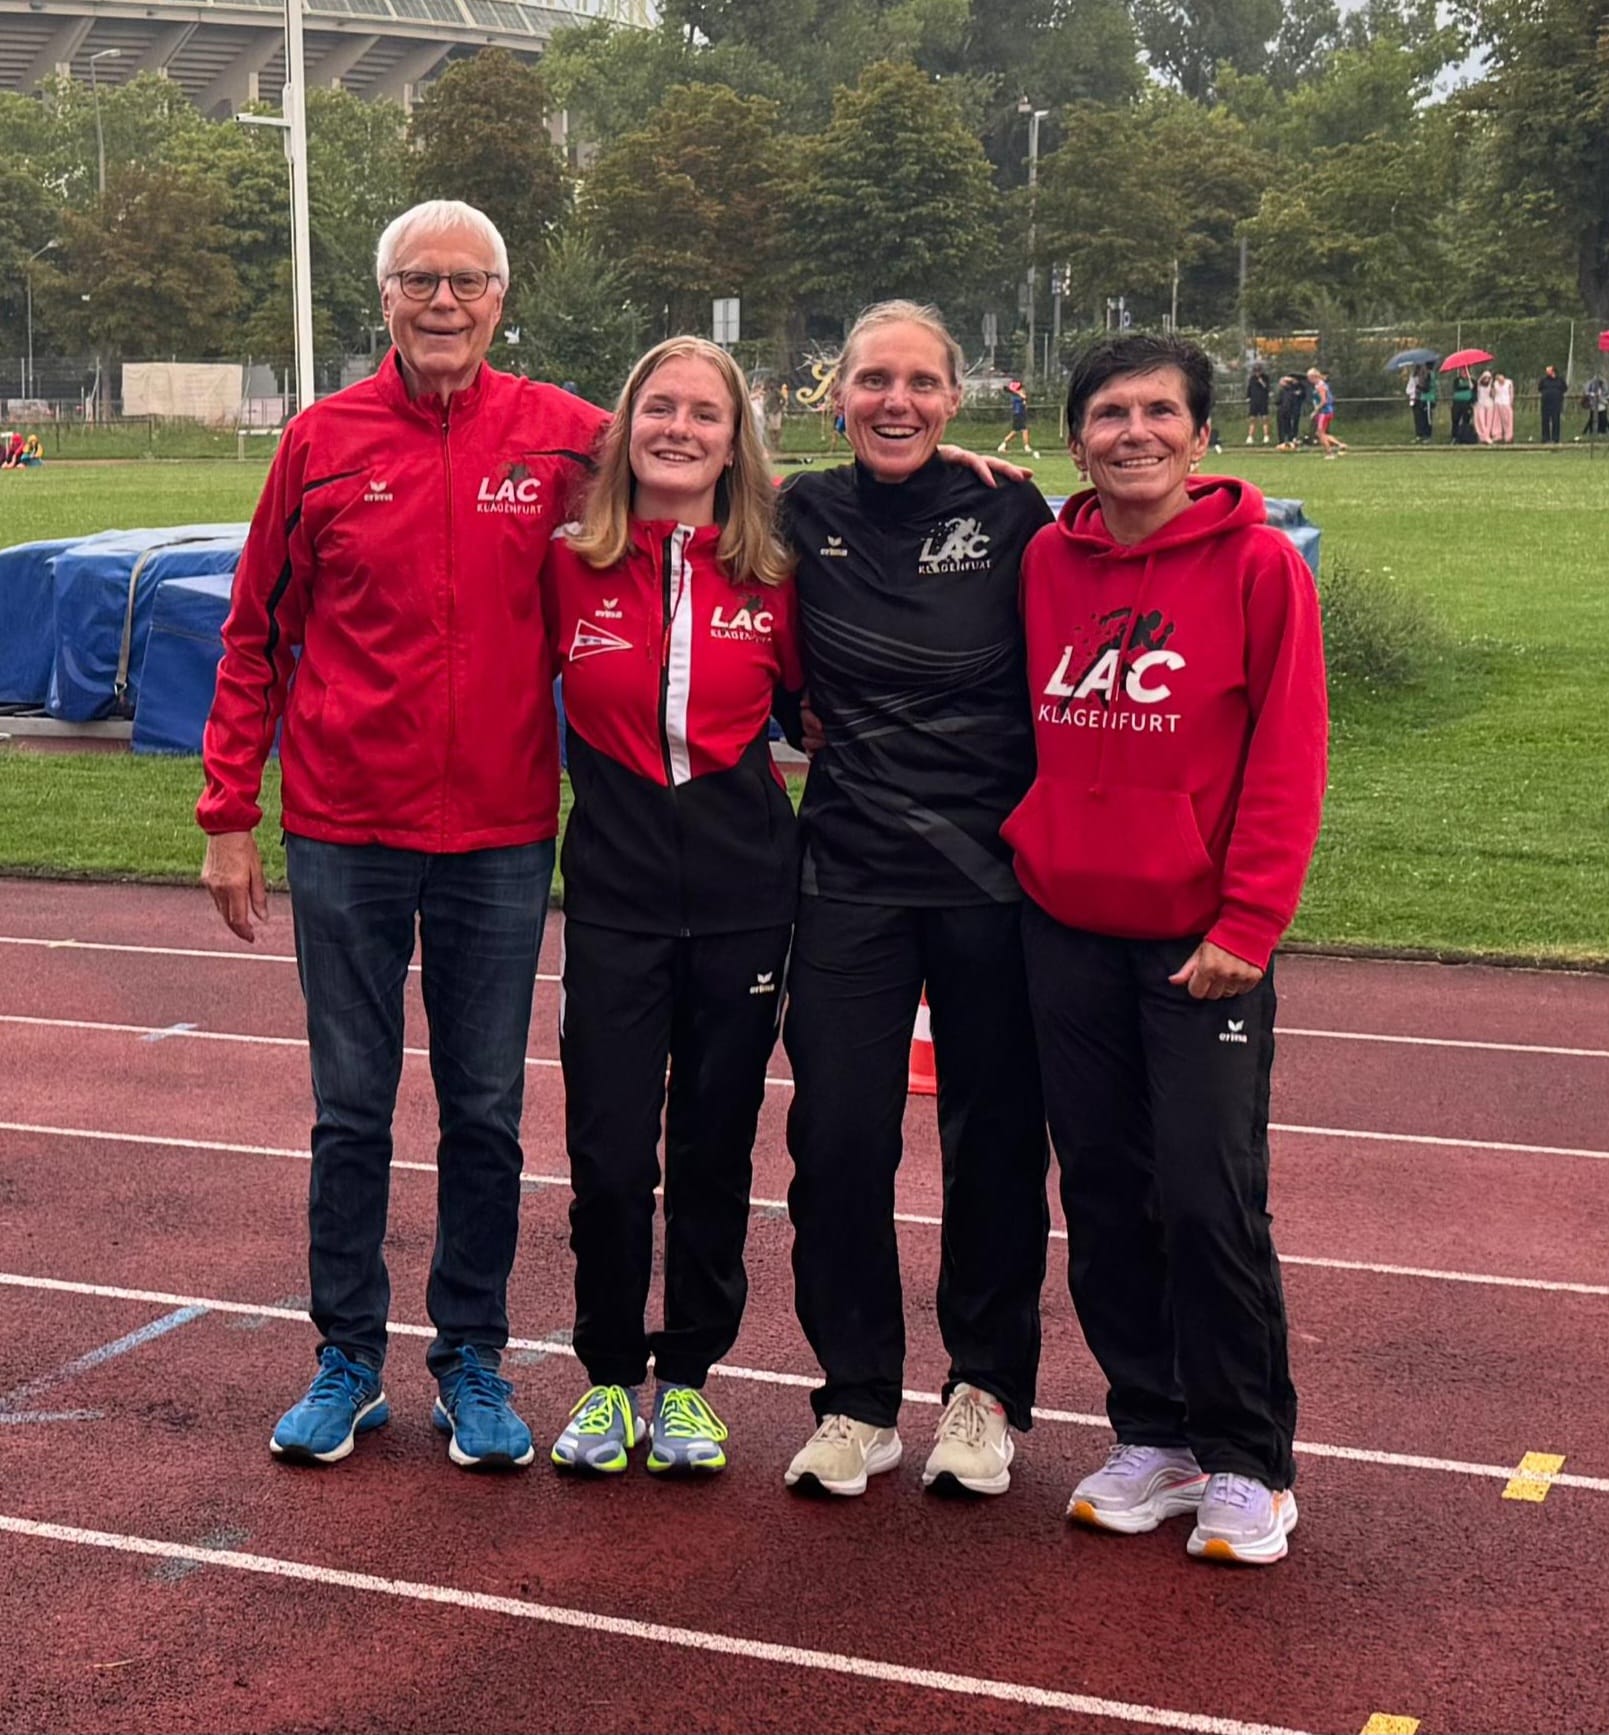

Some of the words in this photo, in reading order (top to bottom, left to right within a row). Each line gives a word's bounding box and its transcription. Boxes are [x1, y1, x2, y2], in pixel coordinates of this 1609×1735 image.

[477, 477, 541, 503] LAC
[477, 502, 543, 515] KLAGENFURT
[918, 534, 991, 562] LAC
[711, 606, 773, 633] LAC
[710, 629, 772, 643] KLAGEN
[1043, 646, 1186, 703] LAC
[1038, 704, 1181, 733] KLAGENFURT
